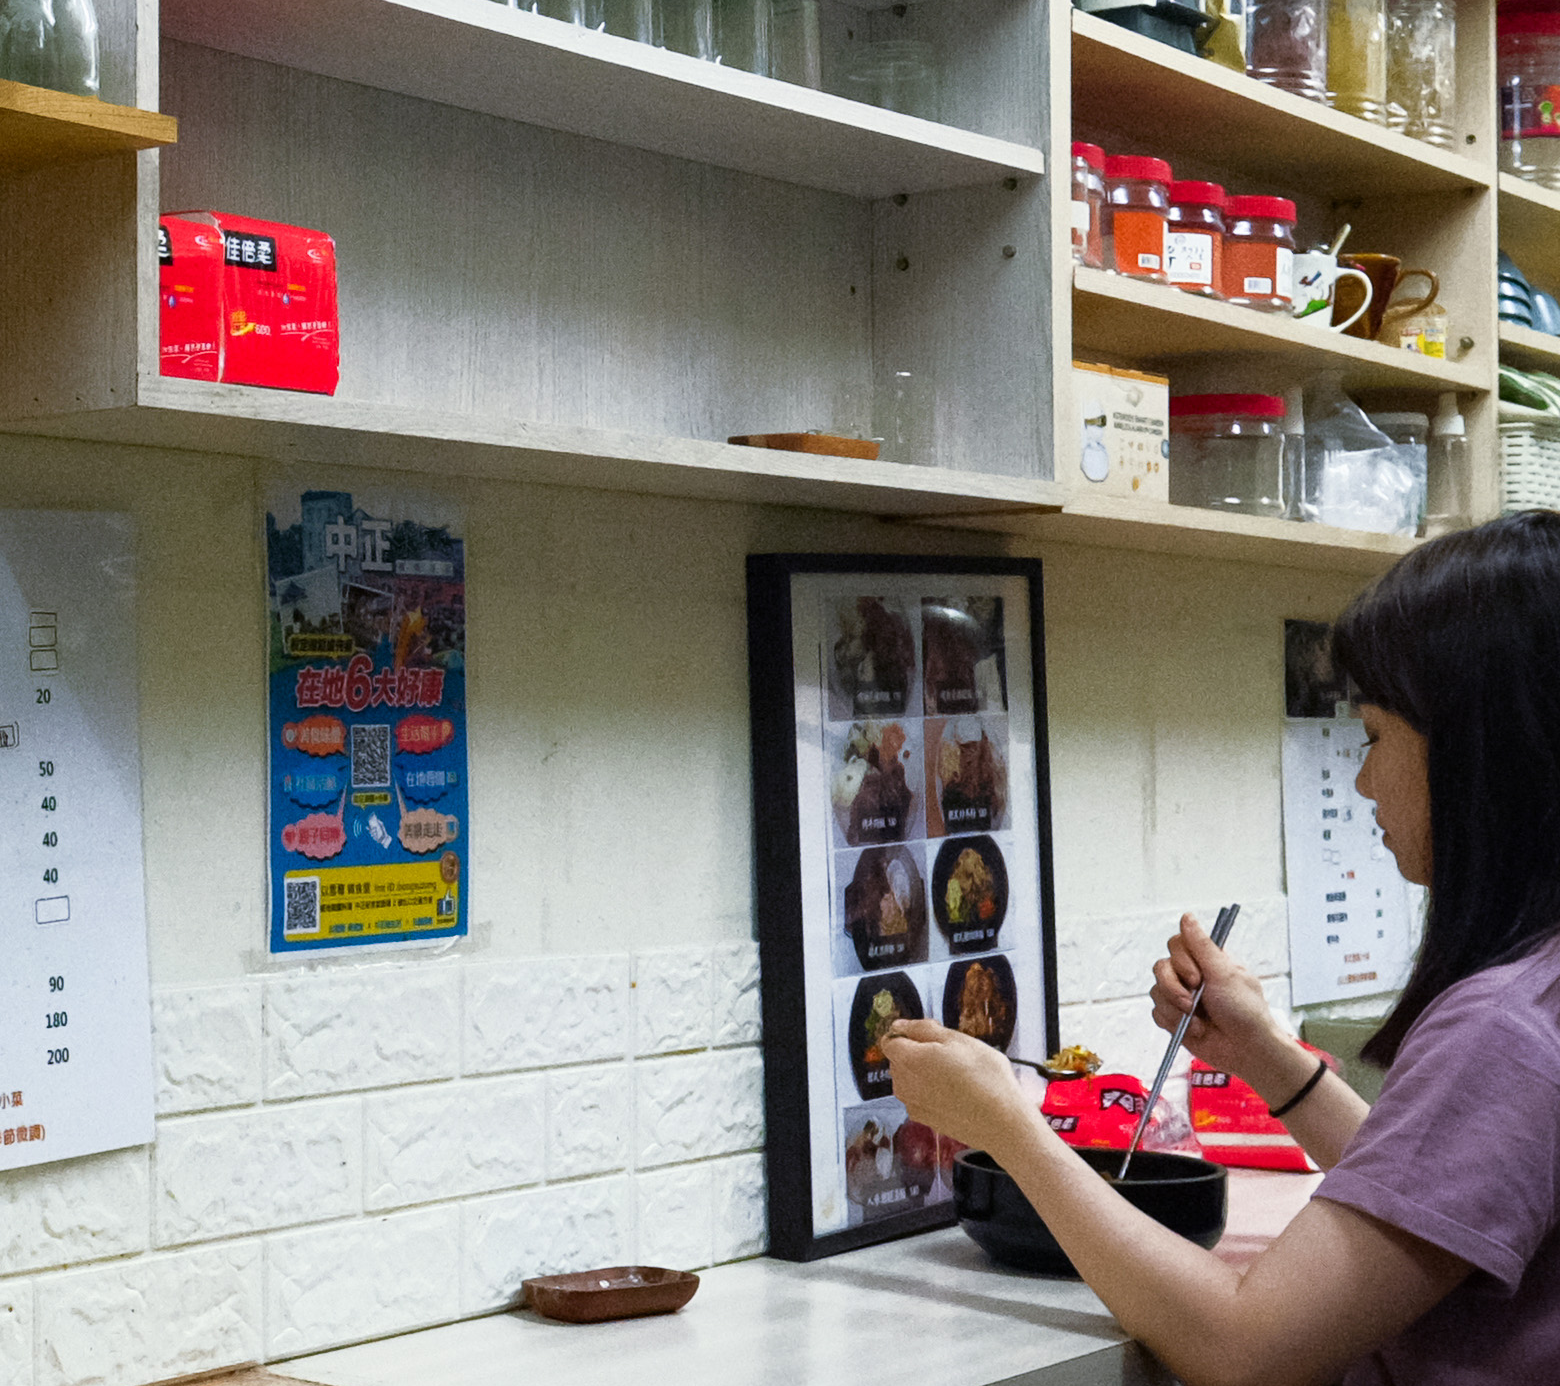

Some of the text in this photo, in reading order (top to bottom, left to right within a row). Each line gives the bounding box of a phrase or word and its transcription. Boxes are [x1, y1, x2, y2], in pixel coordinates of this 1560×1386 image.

[227, 236, 272, 265] 佳倍柔
[324, 516, 394, 573] 中正
[36, 689, 51, 704] 20
[39, 761, 54, 777] 50
[41, 796, 57, 812] 40
[43, 831, 58, 848] 40
[43, 868, 59, 884] 40
[49, 975, 64, 993] 90
[45, 1012, 68, 1029] 180
[47, 1047, 70, 1065] 200
